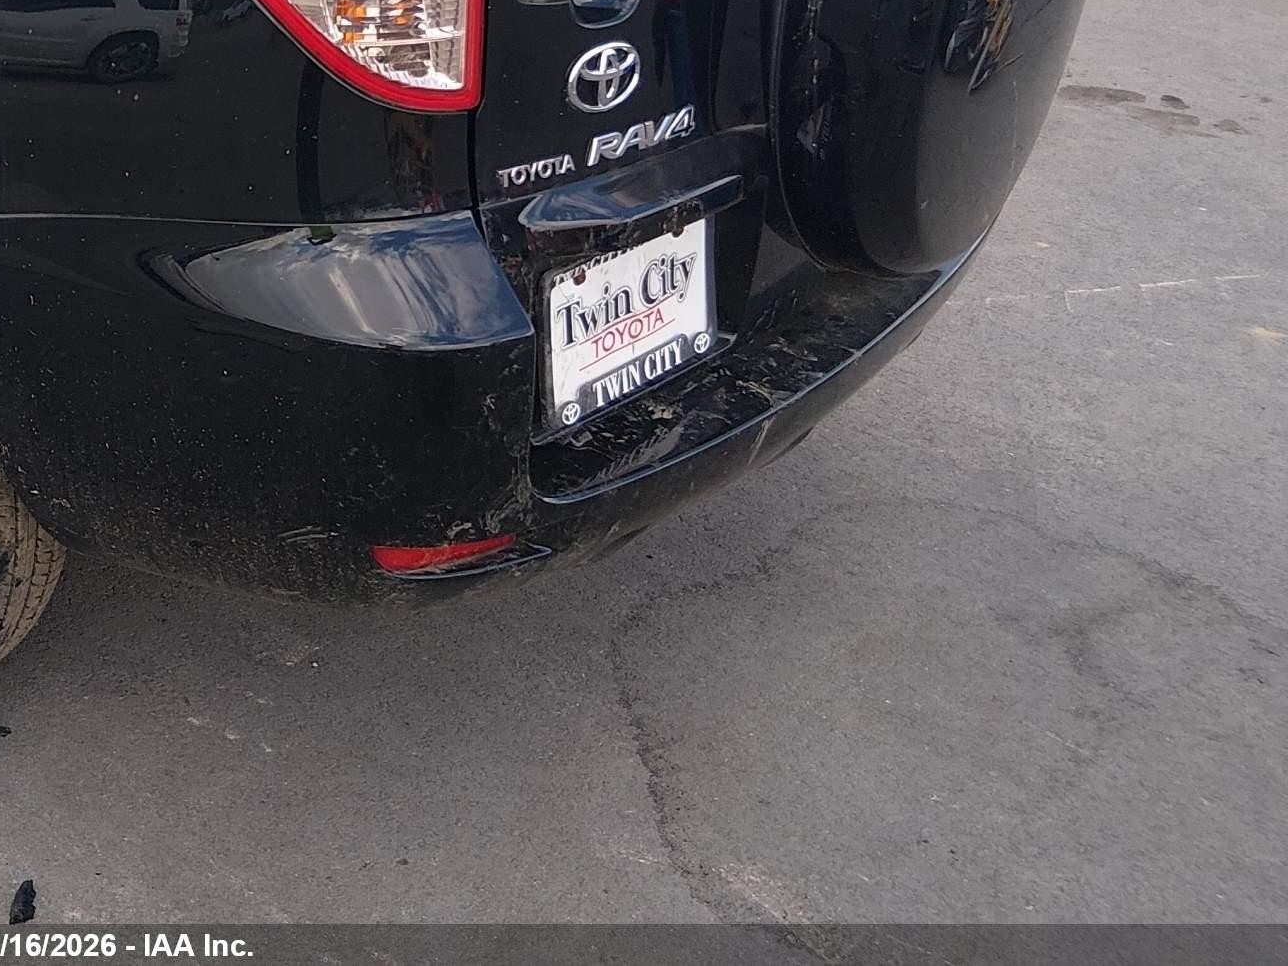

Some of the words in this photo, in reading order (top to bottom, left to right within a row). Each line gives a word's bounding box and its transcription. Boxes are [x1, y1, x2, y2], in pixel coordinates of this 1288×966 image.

[497, 154, 575, 188] TOYOTA
[586, 105, 695, 166] RAV4
[555, 285, 633, 349] Twin
[640, 252, 697, 307] City
[591, 308, 665, 359] TOYOTA
[592, 368, 642, 407] TWIN
[644, 346, 685, 382] CITY
